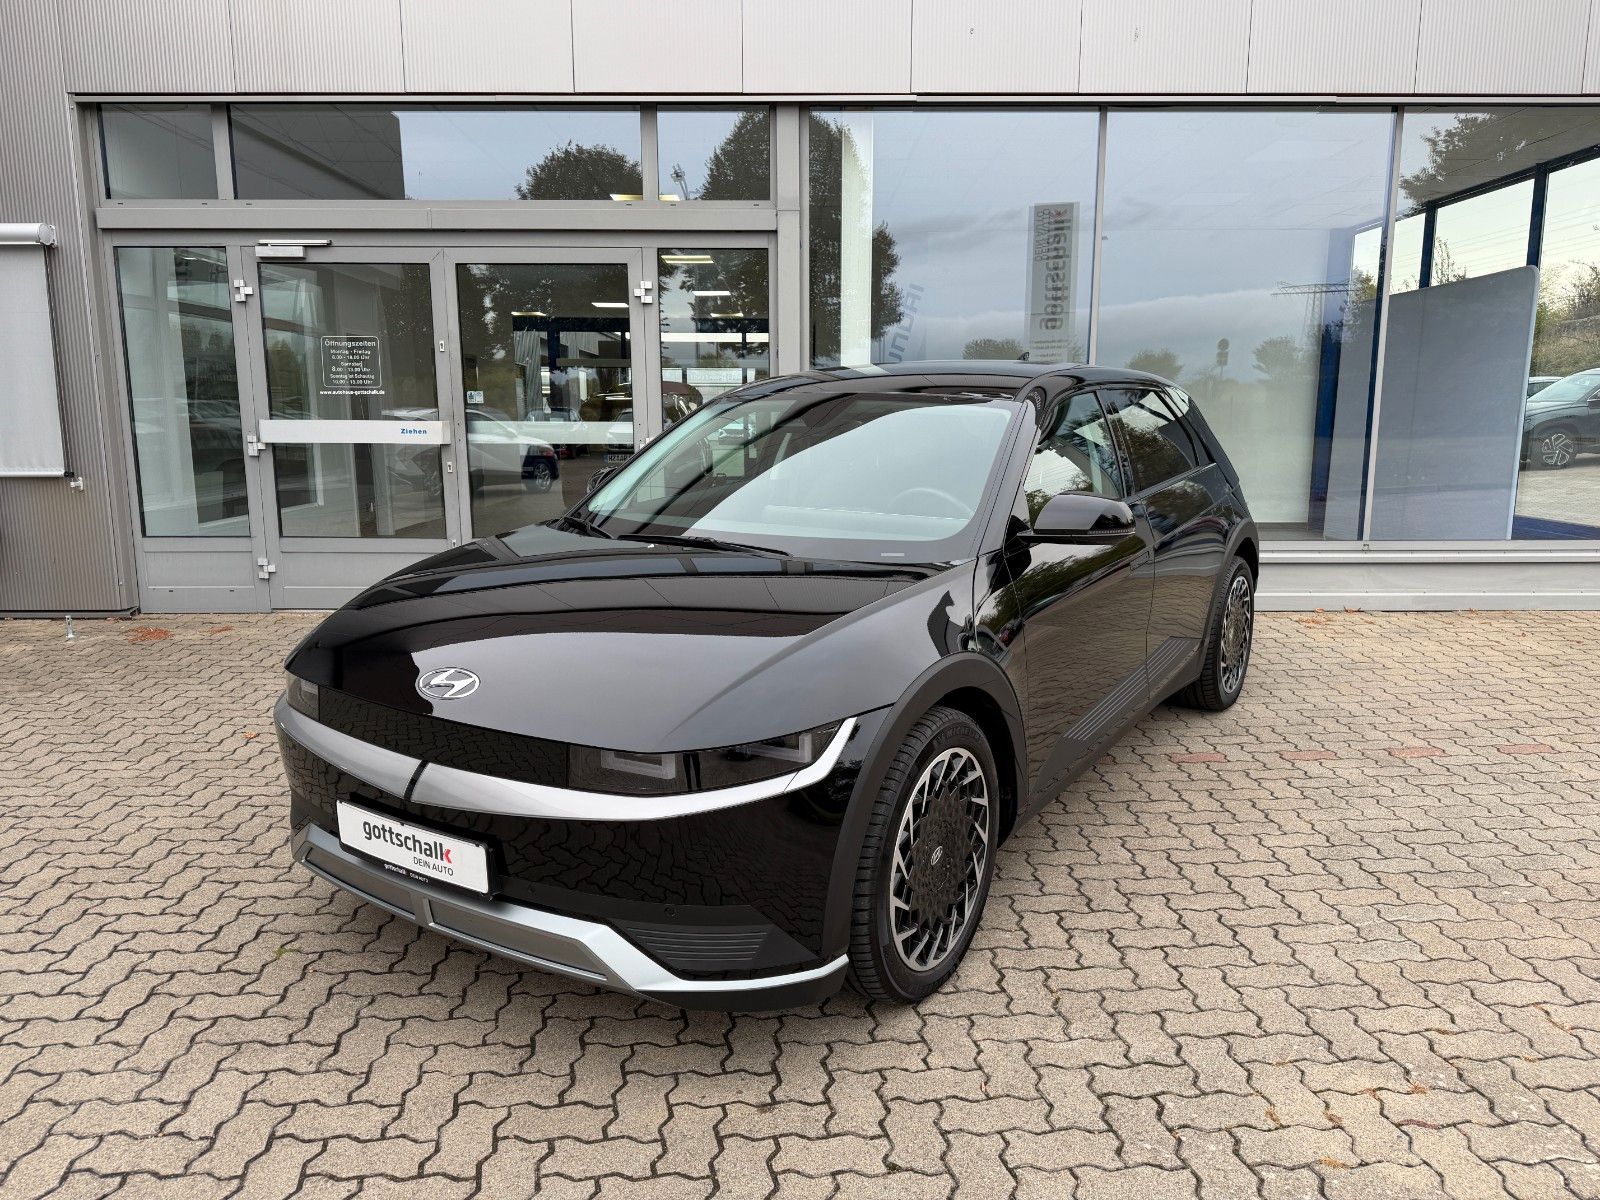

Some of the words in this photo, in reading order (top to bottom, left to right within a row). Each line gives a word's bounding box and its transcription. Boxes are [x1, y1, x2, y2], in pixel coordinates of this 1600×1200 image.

[324, 339, 376, 348] Öffnungszeiten
[363, 821, 453, 865] gottschalk
[413, 857, 431, 869] DEIN
[432, 863, 454, 877] AUTO
